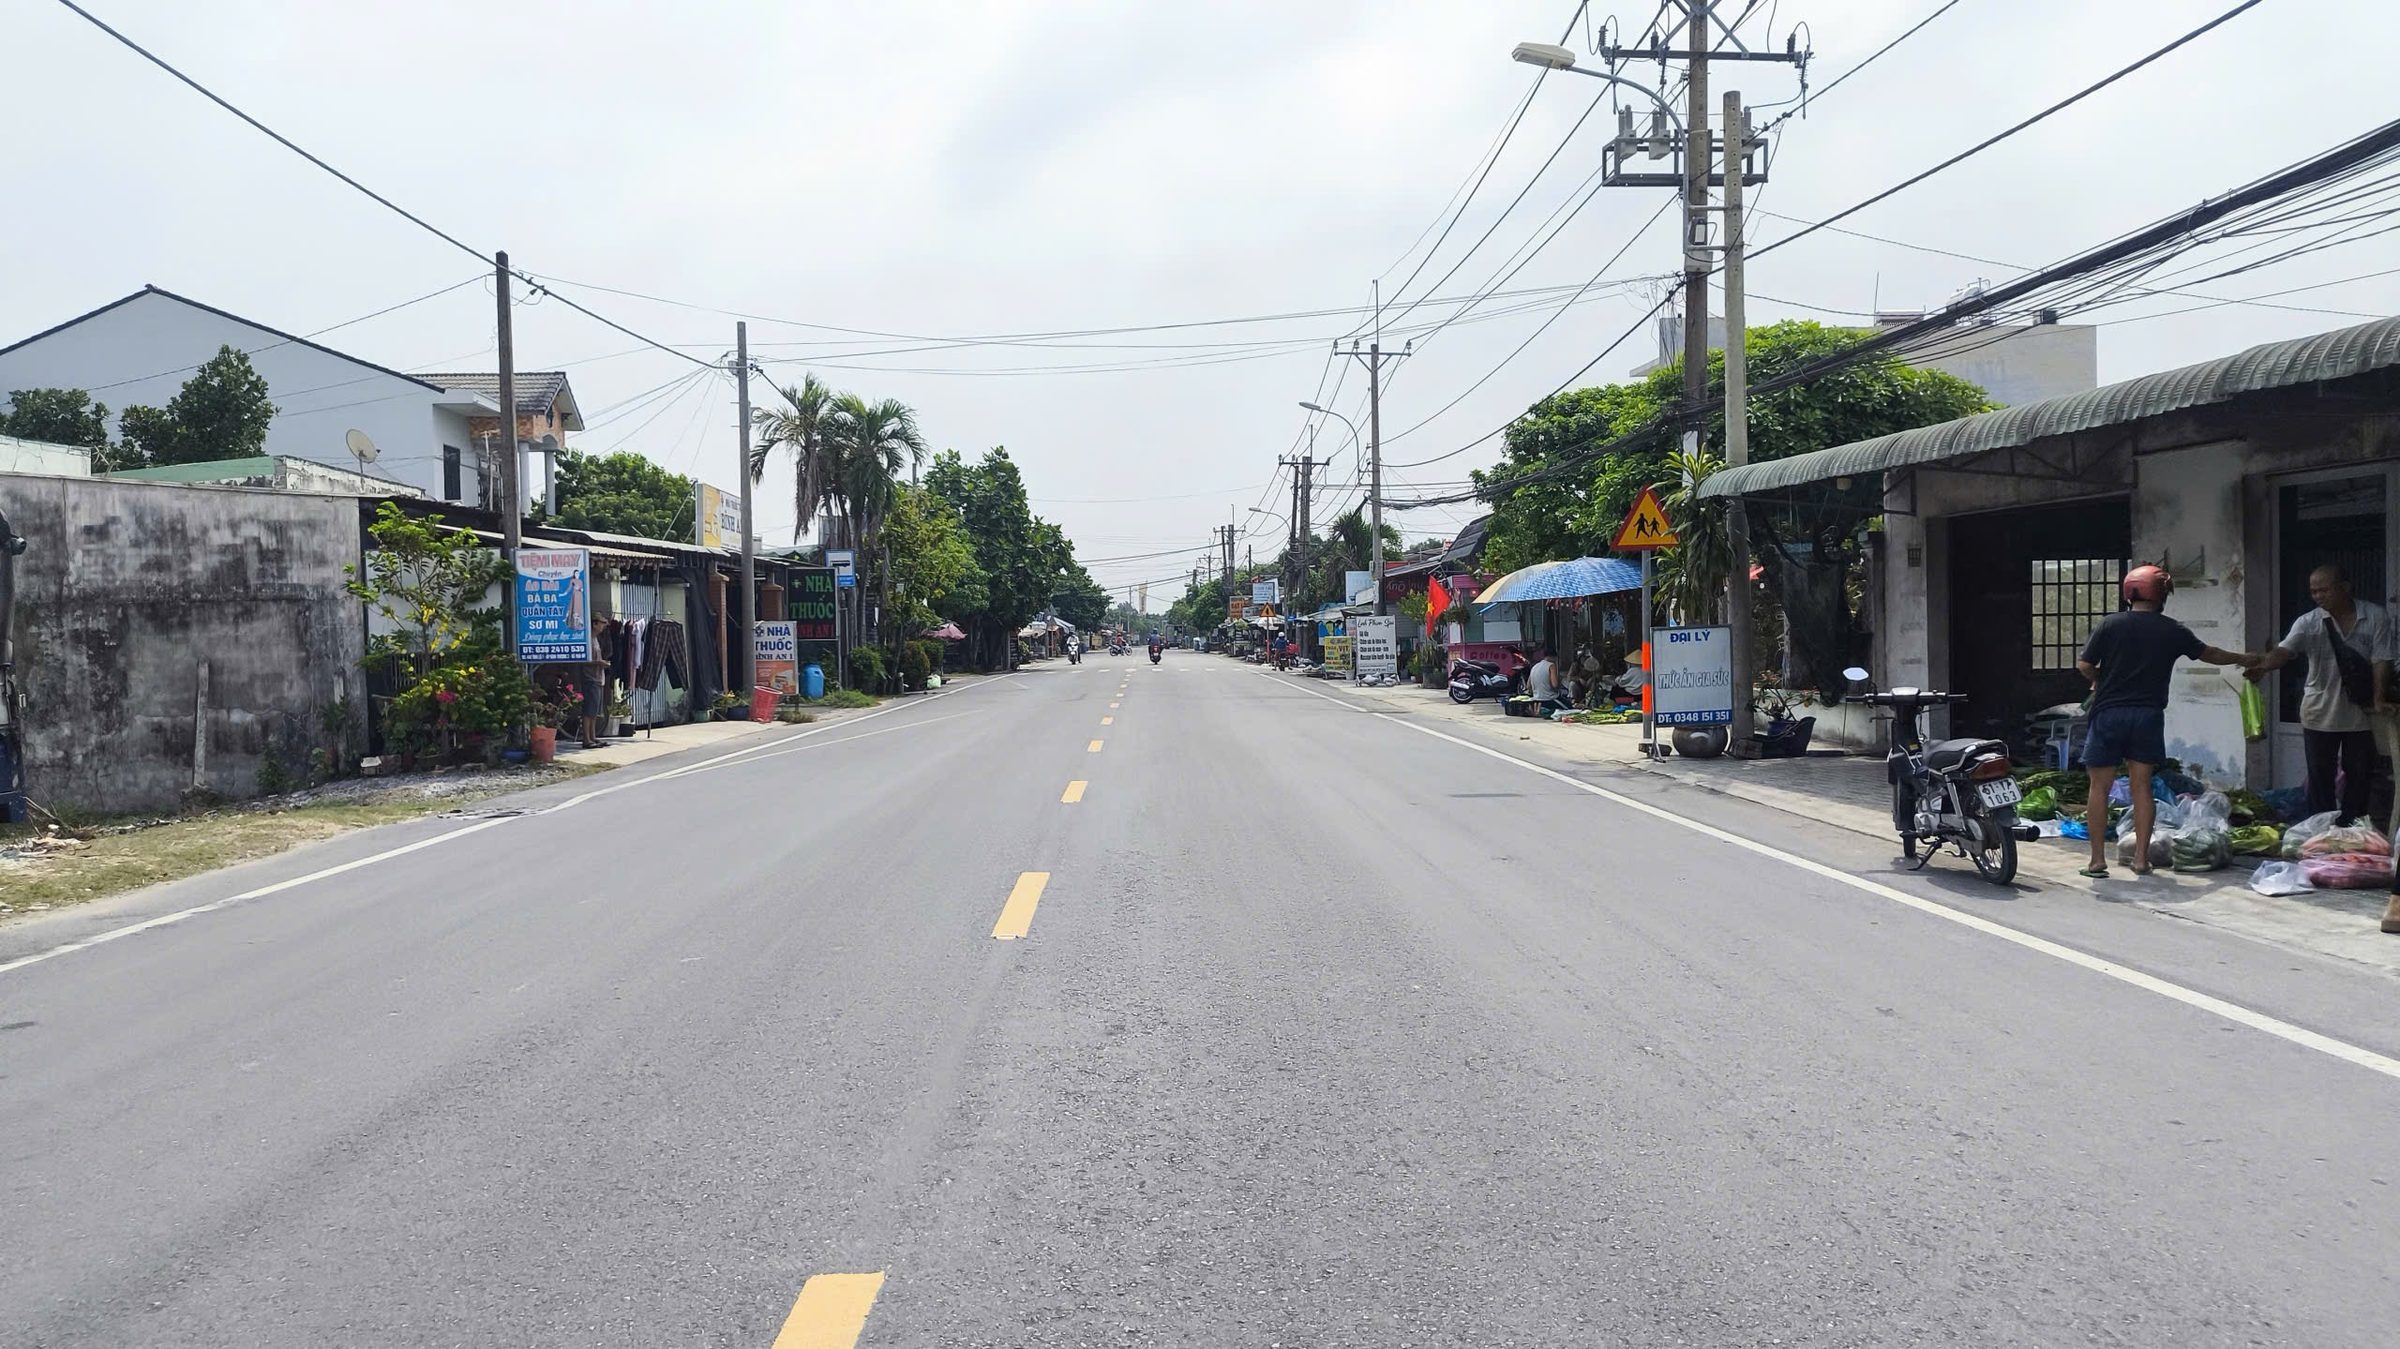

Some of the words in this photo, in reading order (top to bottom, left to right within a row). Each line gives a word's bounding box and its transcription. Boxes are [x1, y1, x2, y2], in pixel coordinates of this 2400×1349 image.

[518, 553, 550, 570] TIỆM
[551, 554, 581, 567] MAY
[525, 580, 540, 591] ÁO
[805, 571, 833, 592] NHÀ
[527, 592, 541, 603] BÀ
[543, 594, 557, 603] BA
[548, 605, 565, 617] TÂY
[789, 594, 834, 619] THUỐC
[529, 620, 542, 630] SƠ
[545, 620, 558, 630] MI
[767, 624, 791, 636] NHÀ
[1670, 632, 1691, 644] ĐẠI
[1695, 629, 1711, 641] LÝ
[1659, 669, 1680, 689] THỨC
[1680, 668, 1695, 688] ĂN
[1696, 671, 1711, 687] GIA
[1713, 668, 1730, 687] SÚC
[1658, 714, 1672, 723] ĐT:
[1674, 712, 1699, 723] 0348
[1702, 711, 1713, 721] 151
[1716, 711, 1729, 721] 351
[1988, 791, 2017, 806] 1063
